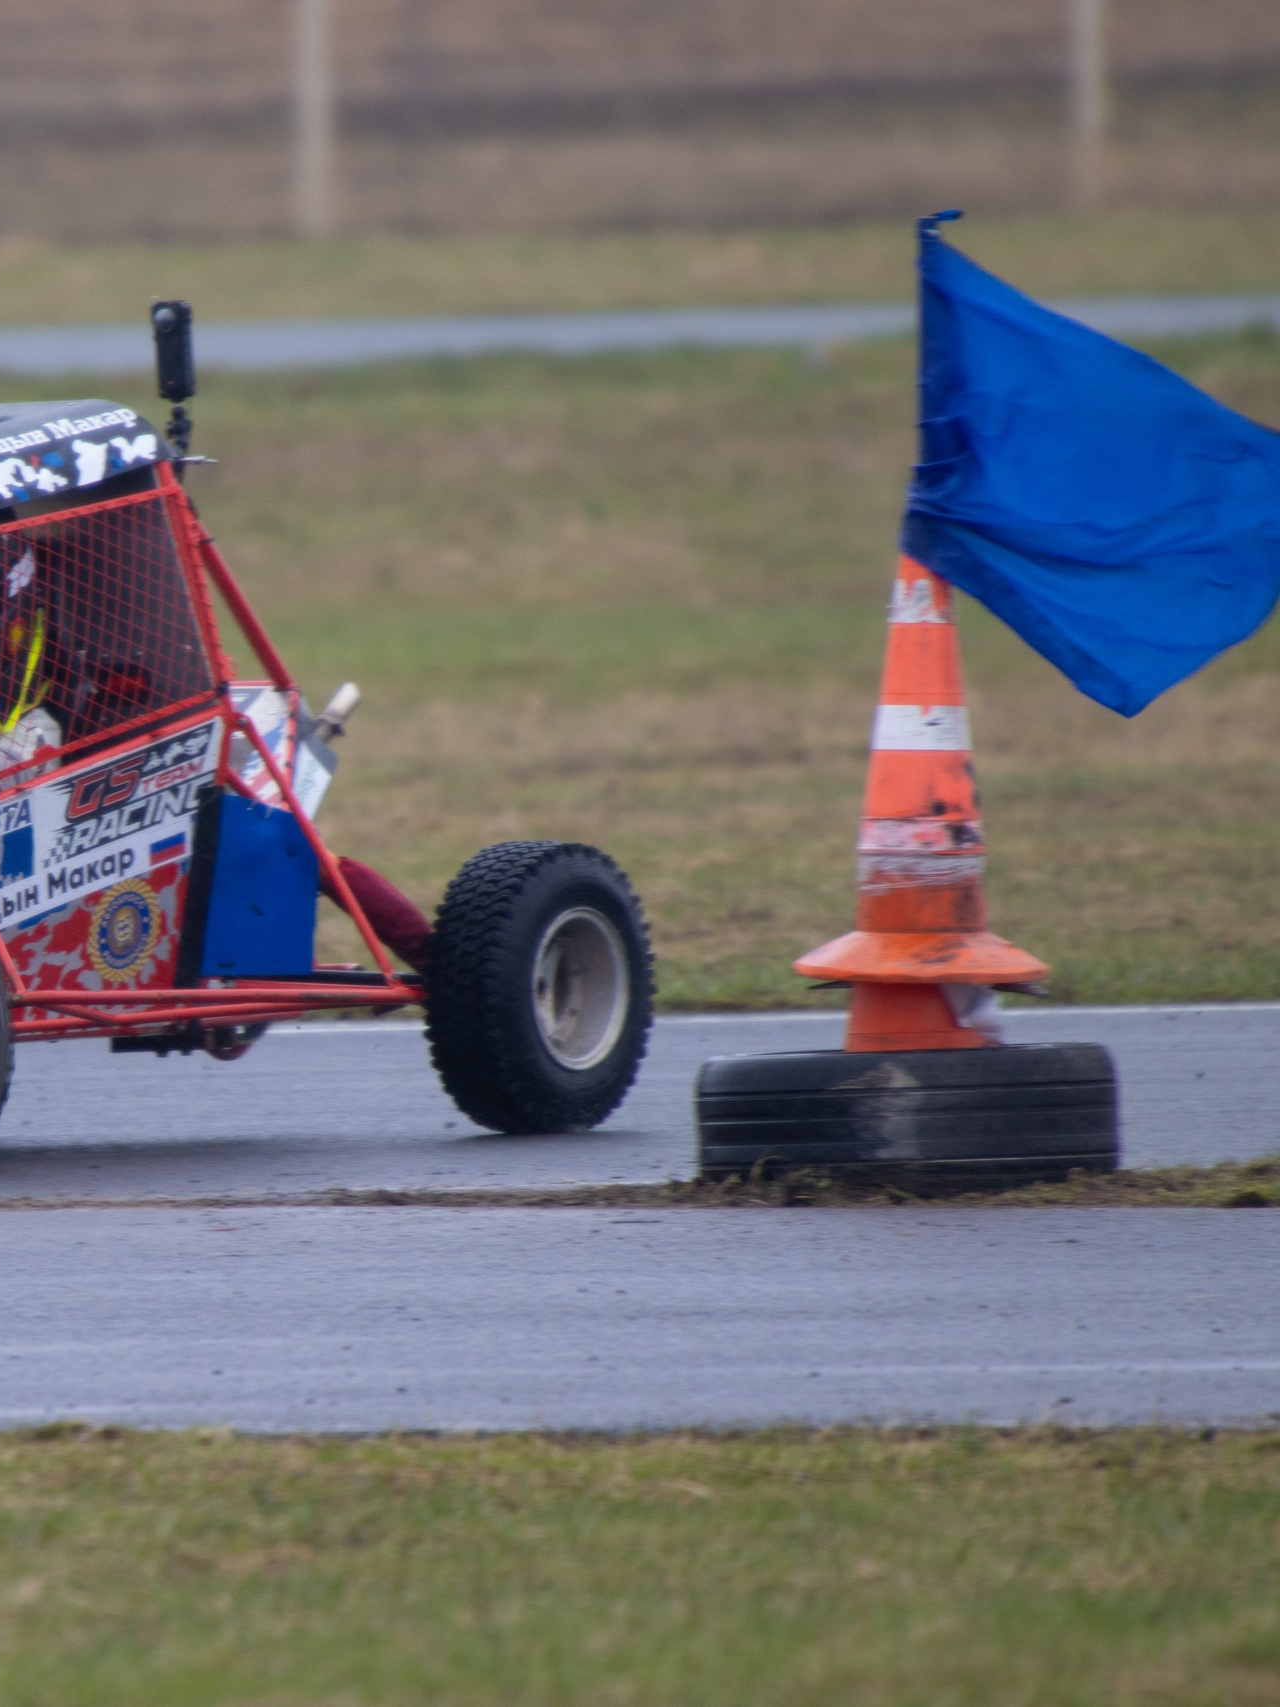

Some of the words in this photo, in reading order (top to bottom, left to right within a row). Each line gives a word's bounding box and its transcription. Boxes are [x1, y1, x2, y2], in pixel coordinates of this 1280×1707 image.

[42, 407, 137, 439] Макар
[67, 753, 146, 820] GS
[48, 849, 134, 899] Макар
